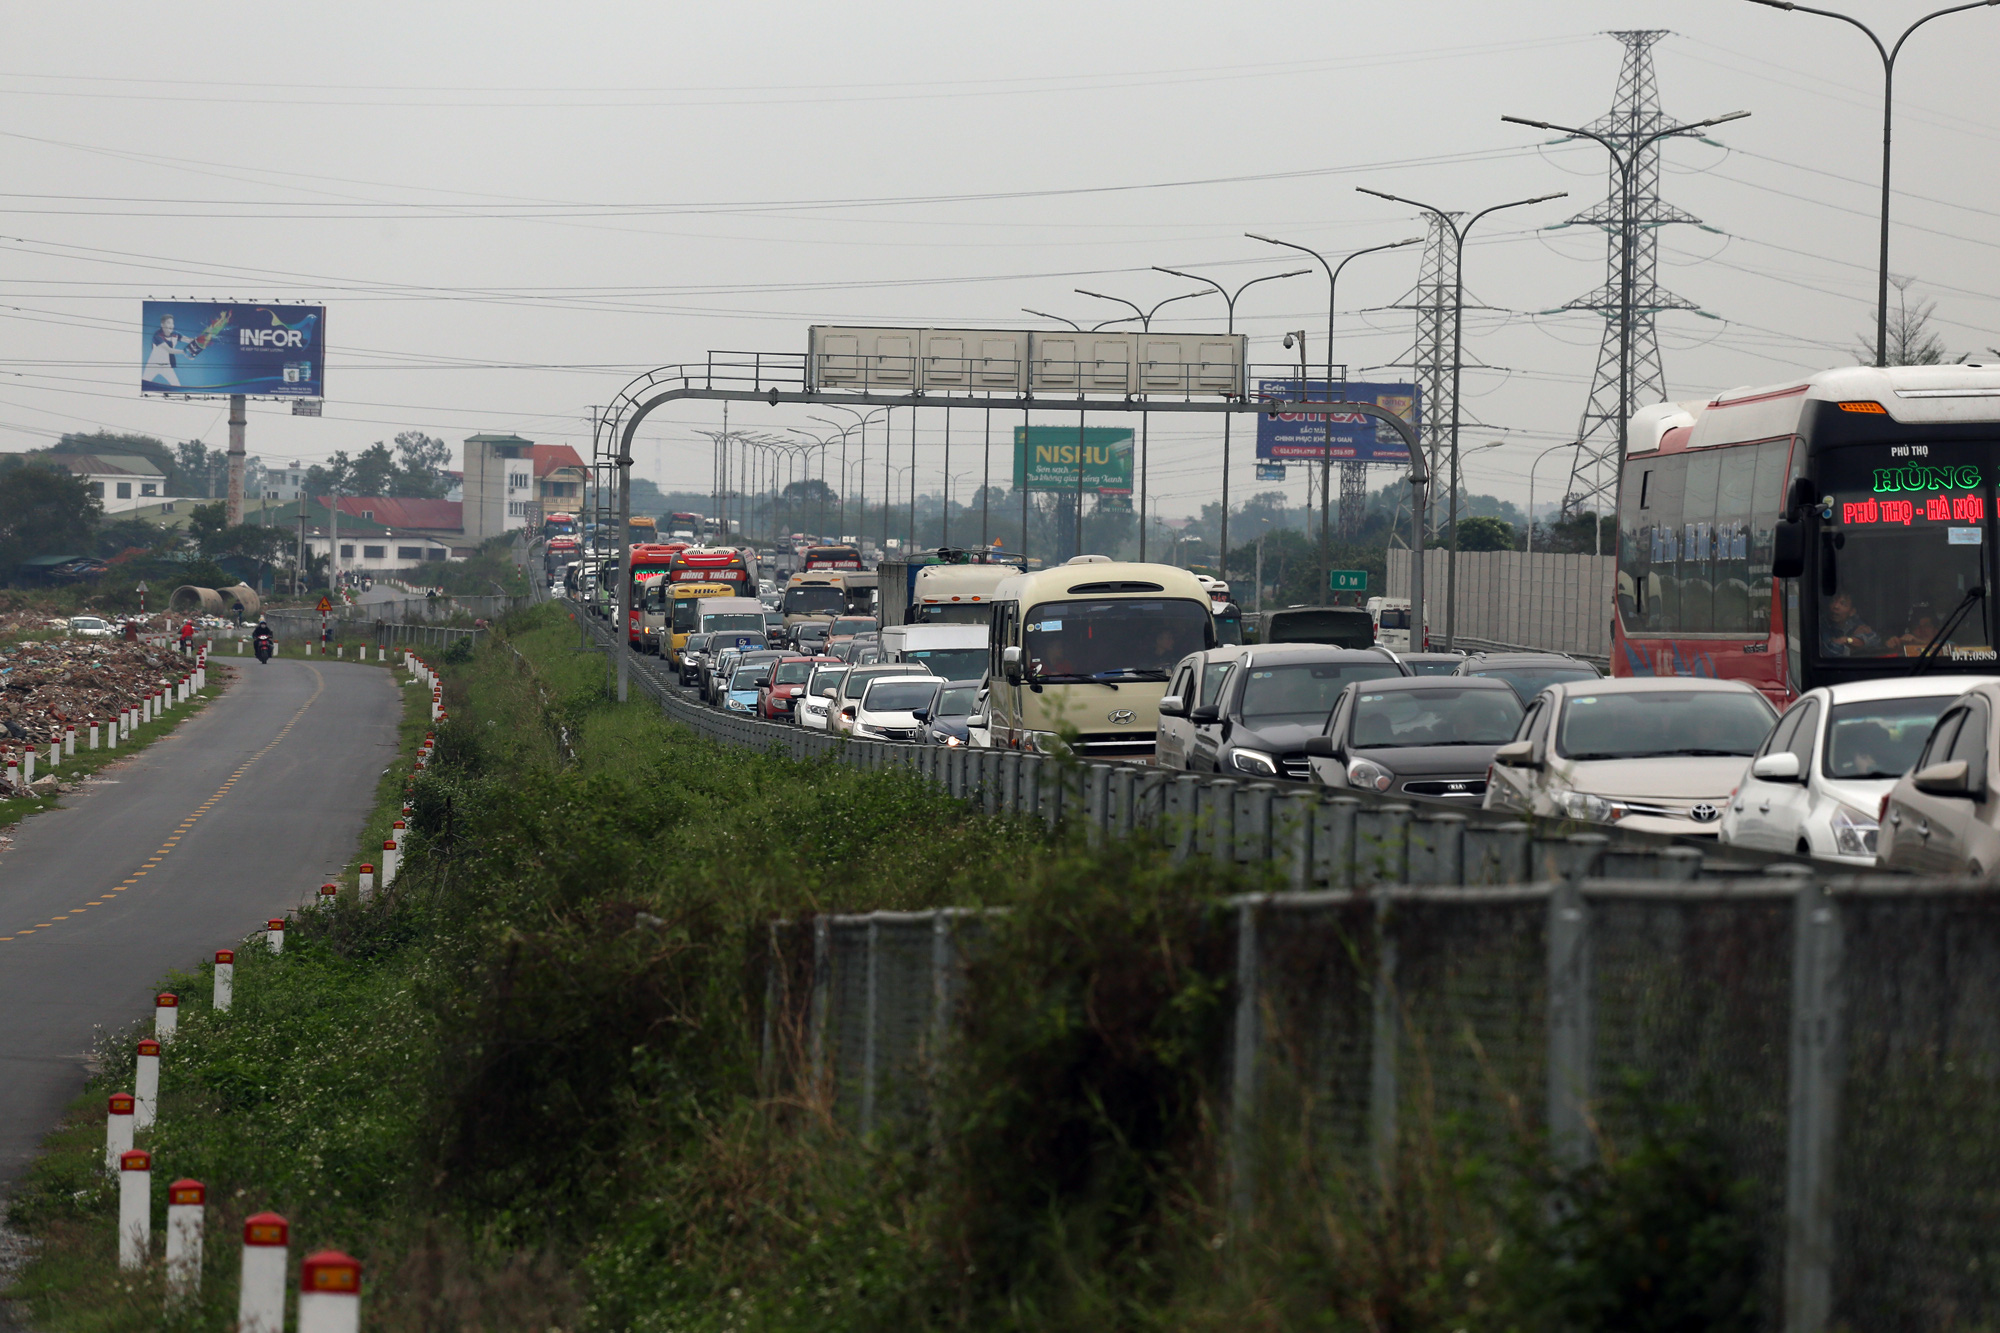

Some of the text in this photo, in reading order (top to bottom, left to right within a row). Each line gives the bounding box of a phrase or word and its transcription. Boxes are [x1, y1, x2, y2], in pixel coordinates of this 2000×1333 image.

[240, 329, 303, 347] INFOR
[1263, 383, 1286, 394] Sơn
[1036, 445, 1109, 464] NISHU
[1911, 445, 1929, 458] THỌ
[1872, 460, 1982, 493] HÙNG
[1843, 498, 1878, 524] PHÚ
[1880, 501, 1913, 525] THỌ
[1926, 495, 1951, 520] HÀ
[1952, 494, 1984, 524] NỘI
[680, 569, 738, 580] HÙNG THẮNG
